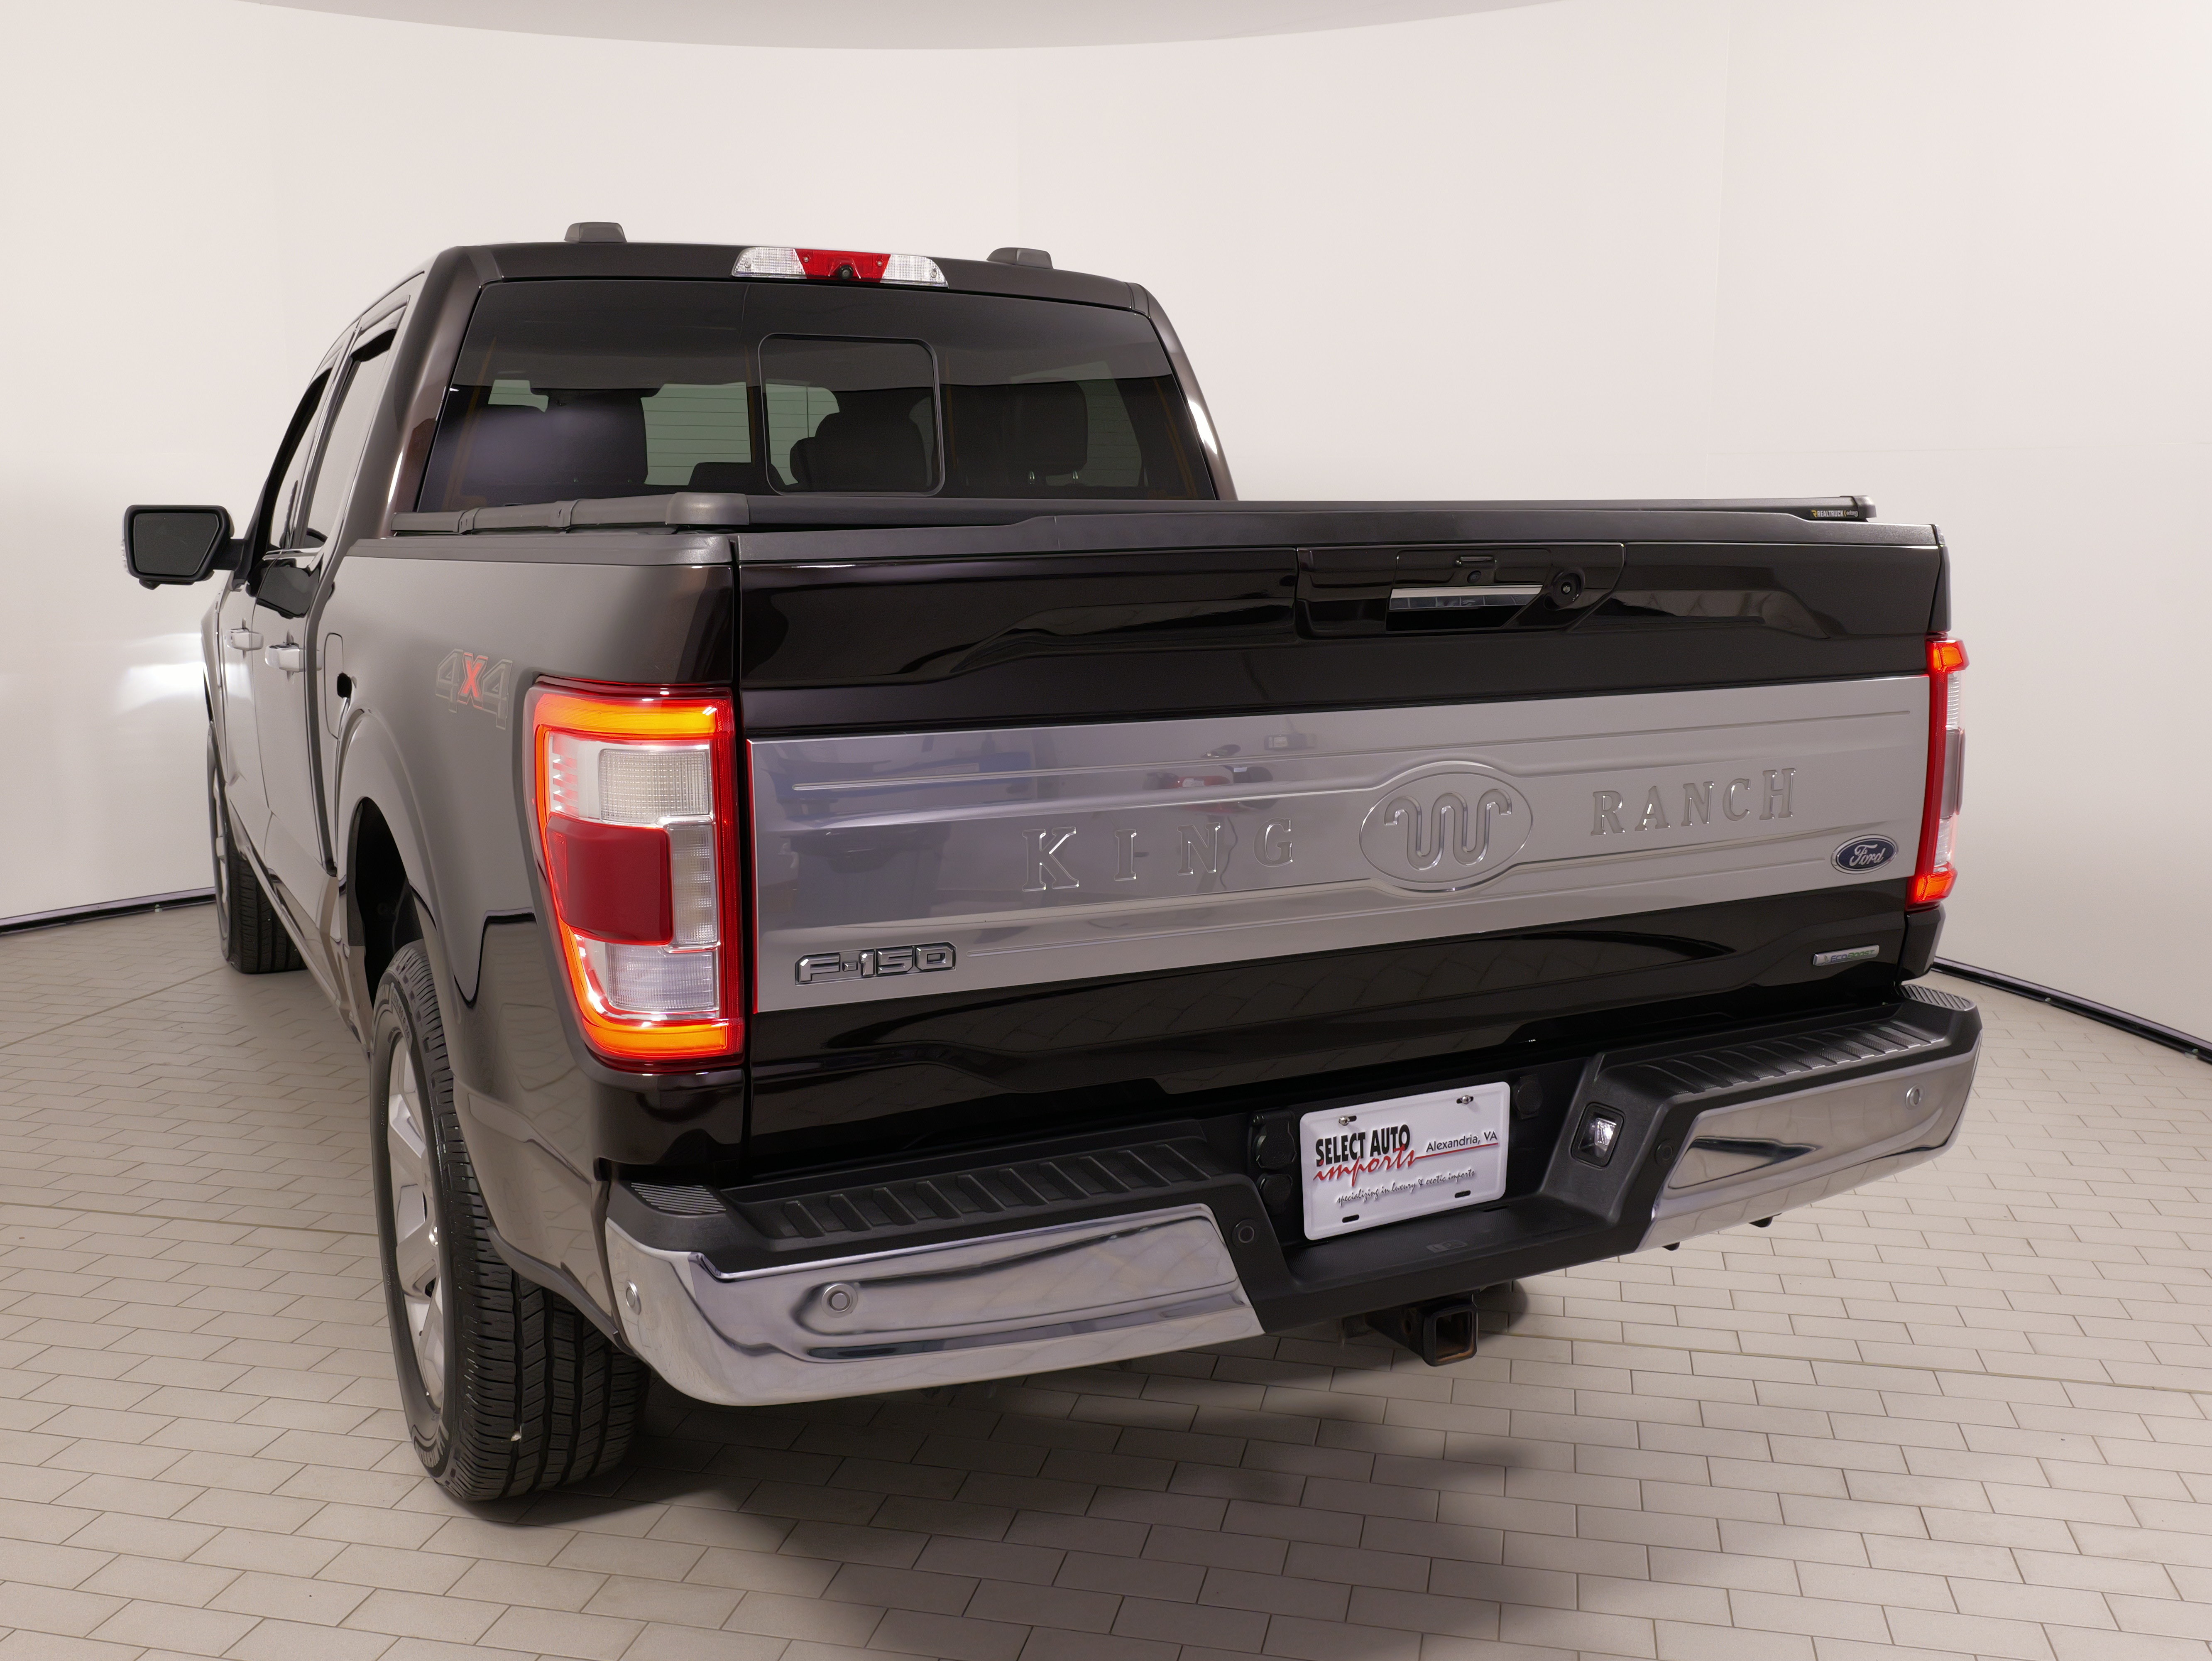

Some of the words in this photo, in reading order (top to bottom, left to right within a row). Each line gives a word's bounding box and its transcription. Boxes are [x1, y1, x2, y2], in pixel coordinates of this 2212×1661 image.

[1022, 817, 1293, 892] KING
[1590, 768, 1796, 836] RANCH
[1849, 844, 1887, 867] Ford
[795, 941, 957, 986] F-150
[1315, 1132, 1365, 1167] SELECT
[1370, 1124, 1410, 1157] AUTO
[1426, 1134, 1481, 1153] Alexandria,
[1483, 1131, 1498, 1142] VA
[1313, 1143, 1417, 1187] imports
[1336, 1188, 1379, 1206] specializing
[1392, 1182, 1415, 1193] luxury
[1418, 1178, 1423, 1187] &
[1426, 1175, 1446, 1185] exotic
[1448, 1169, 1475, 1183] imports
